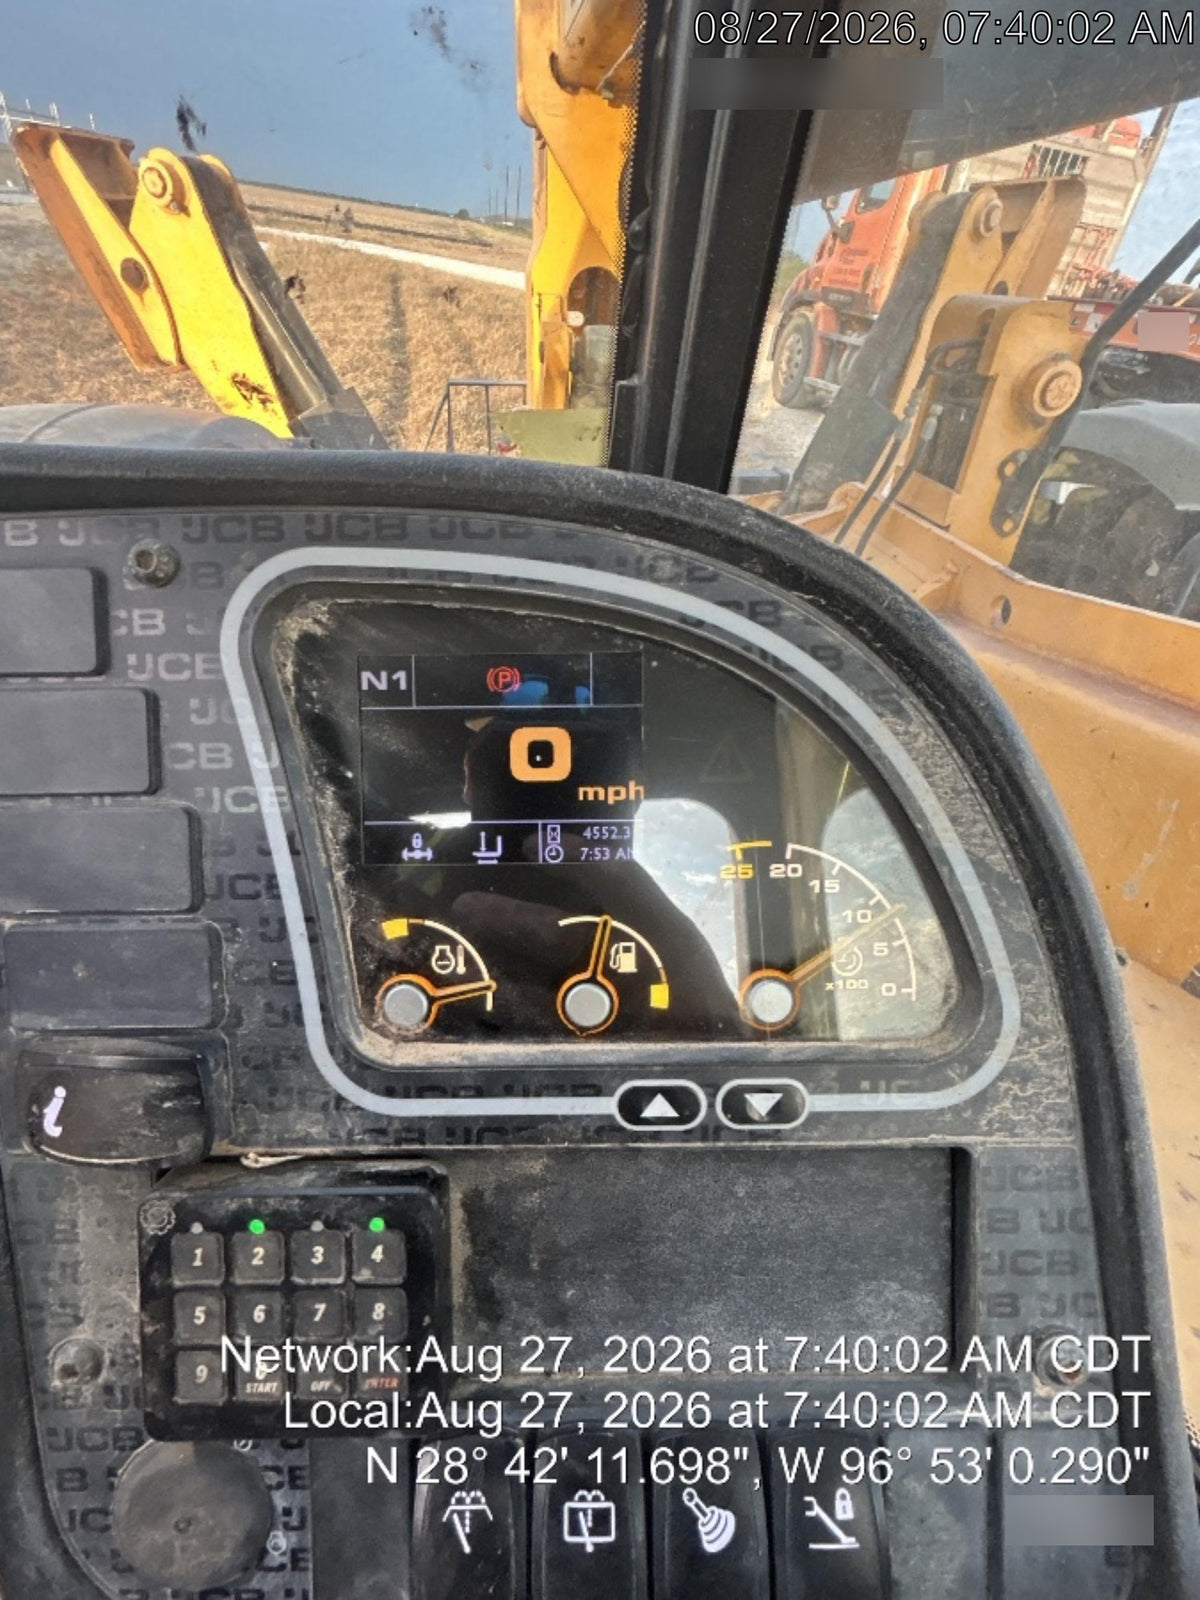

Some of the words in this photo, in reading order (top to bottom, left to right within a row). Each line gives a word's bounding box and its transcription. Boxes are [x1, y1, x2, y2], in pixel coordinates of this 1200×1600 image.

[182, 515, 286, 543] JCB
[304, 514, 409, 542] JCB
[361, 670, 408, 691] N1
[510, 727, 571, 782] 0
[578, 780, 644, 805] mph
[582, 826, 631, 840] 4552.3
[580, 847, 610, 861] 7:53
[720, 863, 754, 879] 25
[769, 863, 803, 878] 20
[808, 880, 840, 893] 15
[842, 909, 872, 923] 10
[873, 942, 889, 956] 5
[825, 979, 869, 991] x100
[881, 982, 896, 997] 0
[192, 1247, 204, 1266] 1
[251, 1247, 265, 1266] 2
[311, 1246, 324, 1264] 3
[370, 1244, 384, 1262] 4
[193, 1306, 207, 1324] 5
[253, 1304, 266, 1323] 6
[313, 1304, 326, 1322] 7
[372, 1303, 386, 1321] 8
[195, 1364, 209, 1384] 9
[246, 1382, 278, 1394] START
[311, 1381, 332, 1392] OFF
